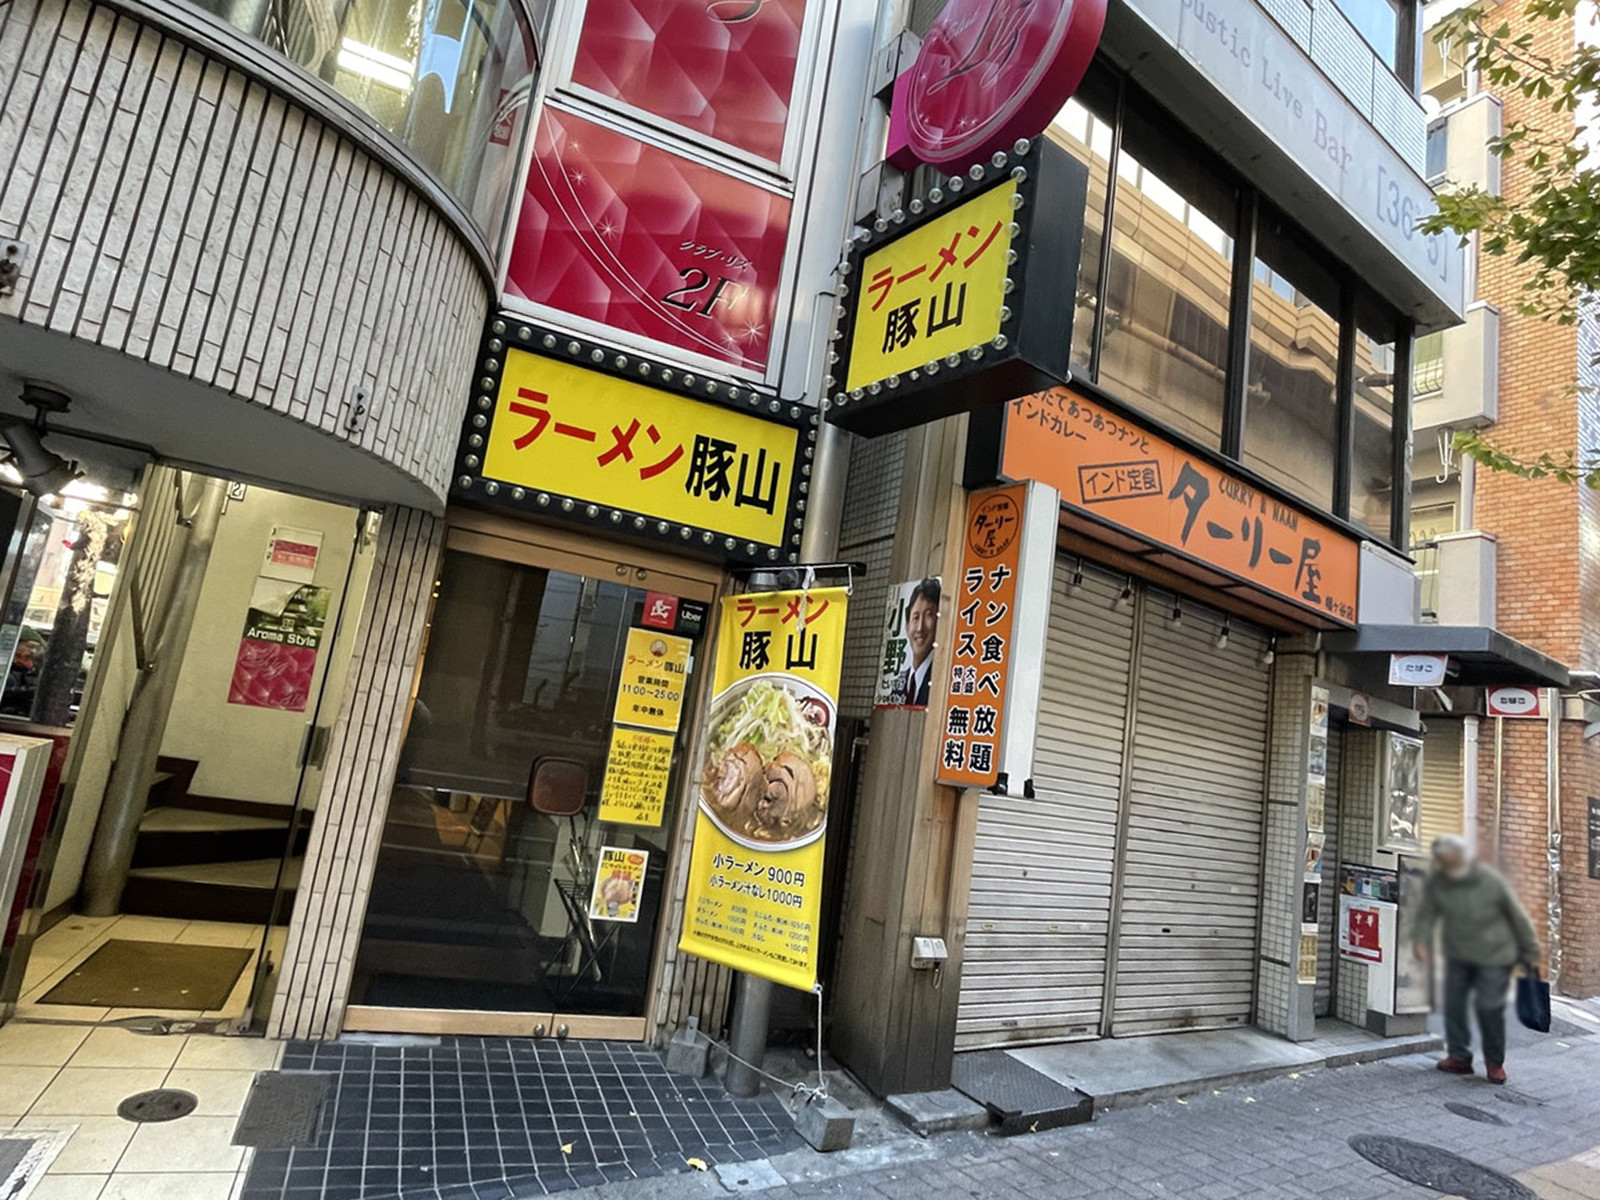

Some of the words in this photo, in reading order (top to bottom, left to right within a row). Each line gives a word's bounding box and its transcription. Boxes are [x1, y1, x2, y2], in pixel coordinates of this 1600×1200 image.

[1262, 57, 1304, 120] Live
[1313, 110, 1352, 174] Bar
[661, 267, 749, 319] 2F
[867, 220, 1003, 312] ラーメン
[882, 281, 967, 354] 豚山
[509, 387, 781, 516] ラーメン豚山
[1012, 399, 1087, 441] インドカレー
[1032, 389, 1150, 454] たてあつあつナンと
[1086, 468, 1157, 495] インド定食
[1219, 476, 1254, 508] CURRY
[1272, 503, 1300, 532] NAAN
[1168, 461, 1321, 604] ターリー屋
[247, 627, 284, 642] Aroma
[287, 633, 316, 647] Style
[737, 594, 830, 628] ラーメン
[883, 597, 908, 677] 小野
[956, 567, 984, 657] ライス
[739, 627, 818, 670] 豚山
[968, 564, 1011, 774] ナン食べ放題
[943, 706, 969, 769] 無料
